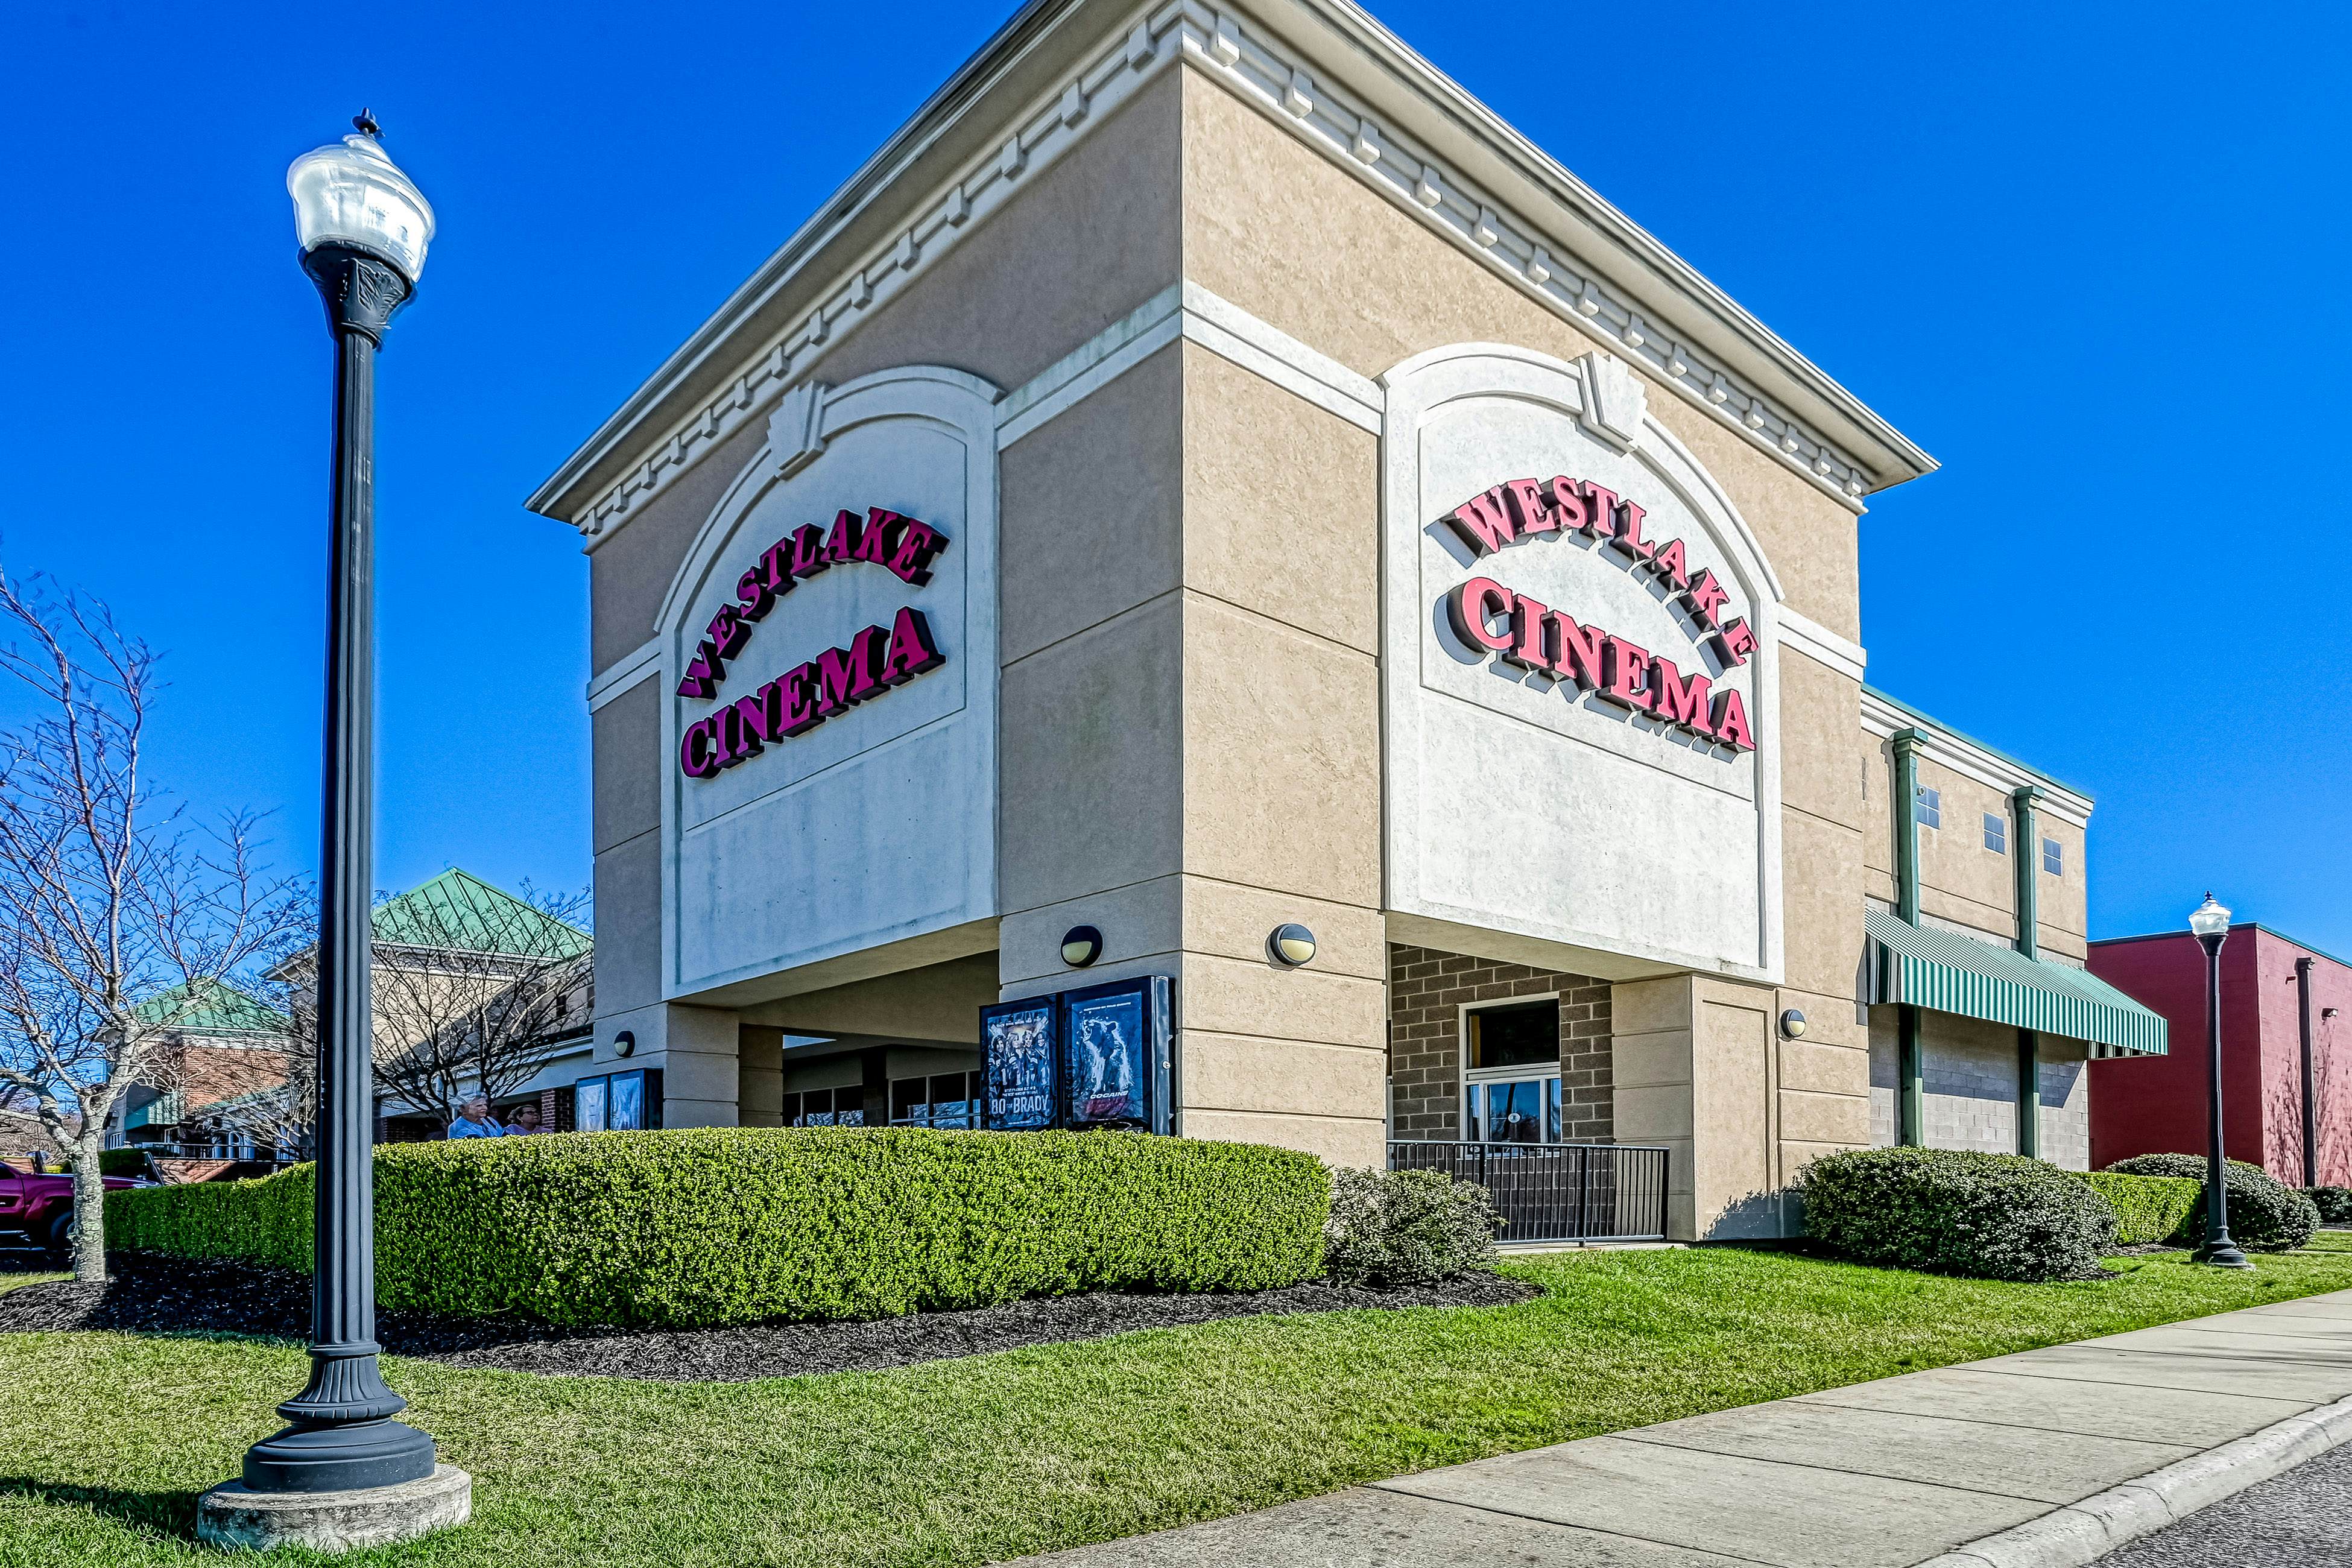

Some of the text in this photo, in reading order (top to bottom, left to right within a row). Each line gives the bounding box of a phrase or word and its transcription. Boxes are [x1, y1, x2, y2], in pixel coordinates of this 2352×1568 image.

[676, 506, 949, 700] WESTLAKE
[1449, 476, 1759, 666] WESTLAKE
[681, 605, 946, 779] CINEMA
[1449, 577, 1757, 753] CINEMA
[1013, 1094, 1049, 1113] BRADY
